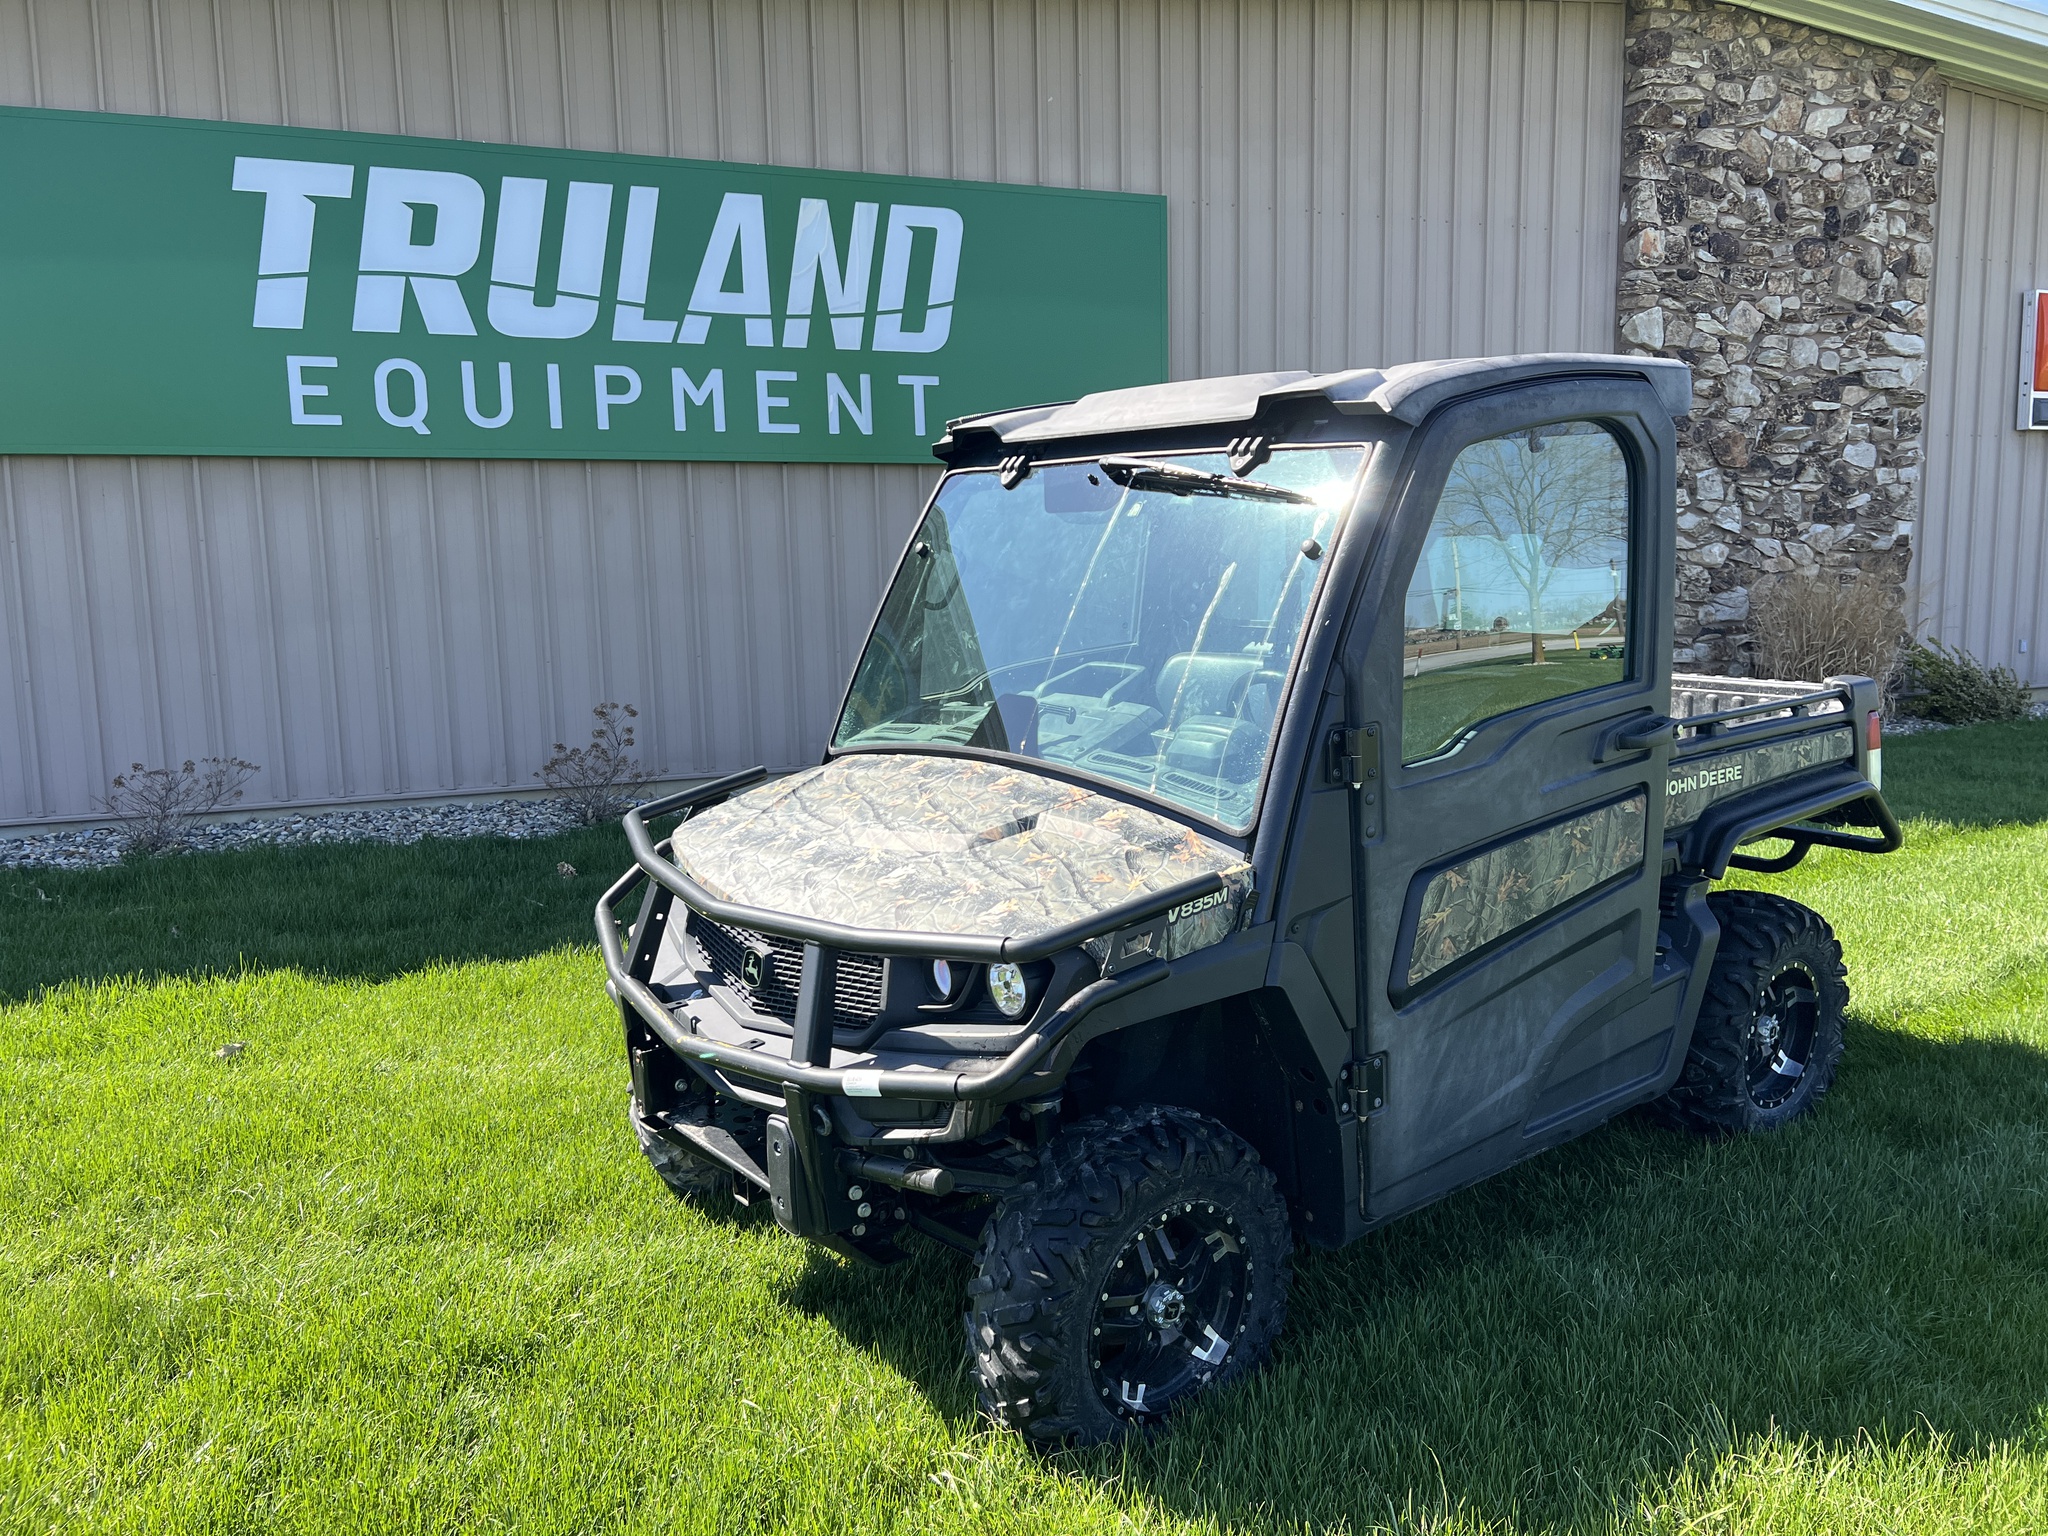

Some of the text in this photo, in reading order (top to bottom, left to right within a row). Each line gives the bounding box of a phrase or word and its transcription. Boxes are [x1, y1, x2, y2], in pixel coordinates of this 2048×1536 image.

[231, 155, 965, 354] TRULAND
[286, 355, 941, 437] EQUIPMENT
[1700, 765, 1742, 789] DEERE
